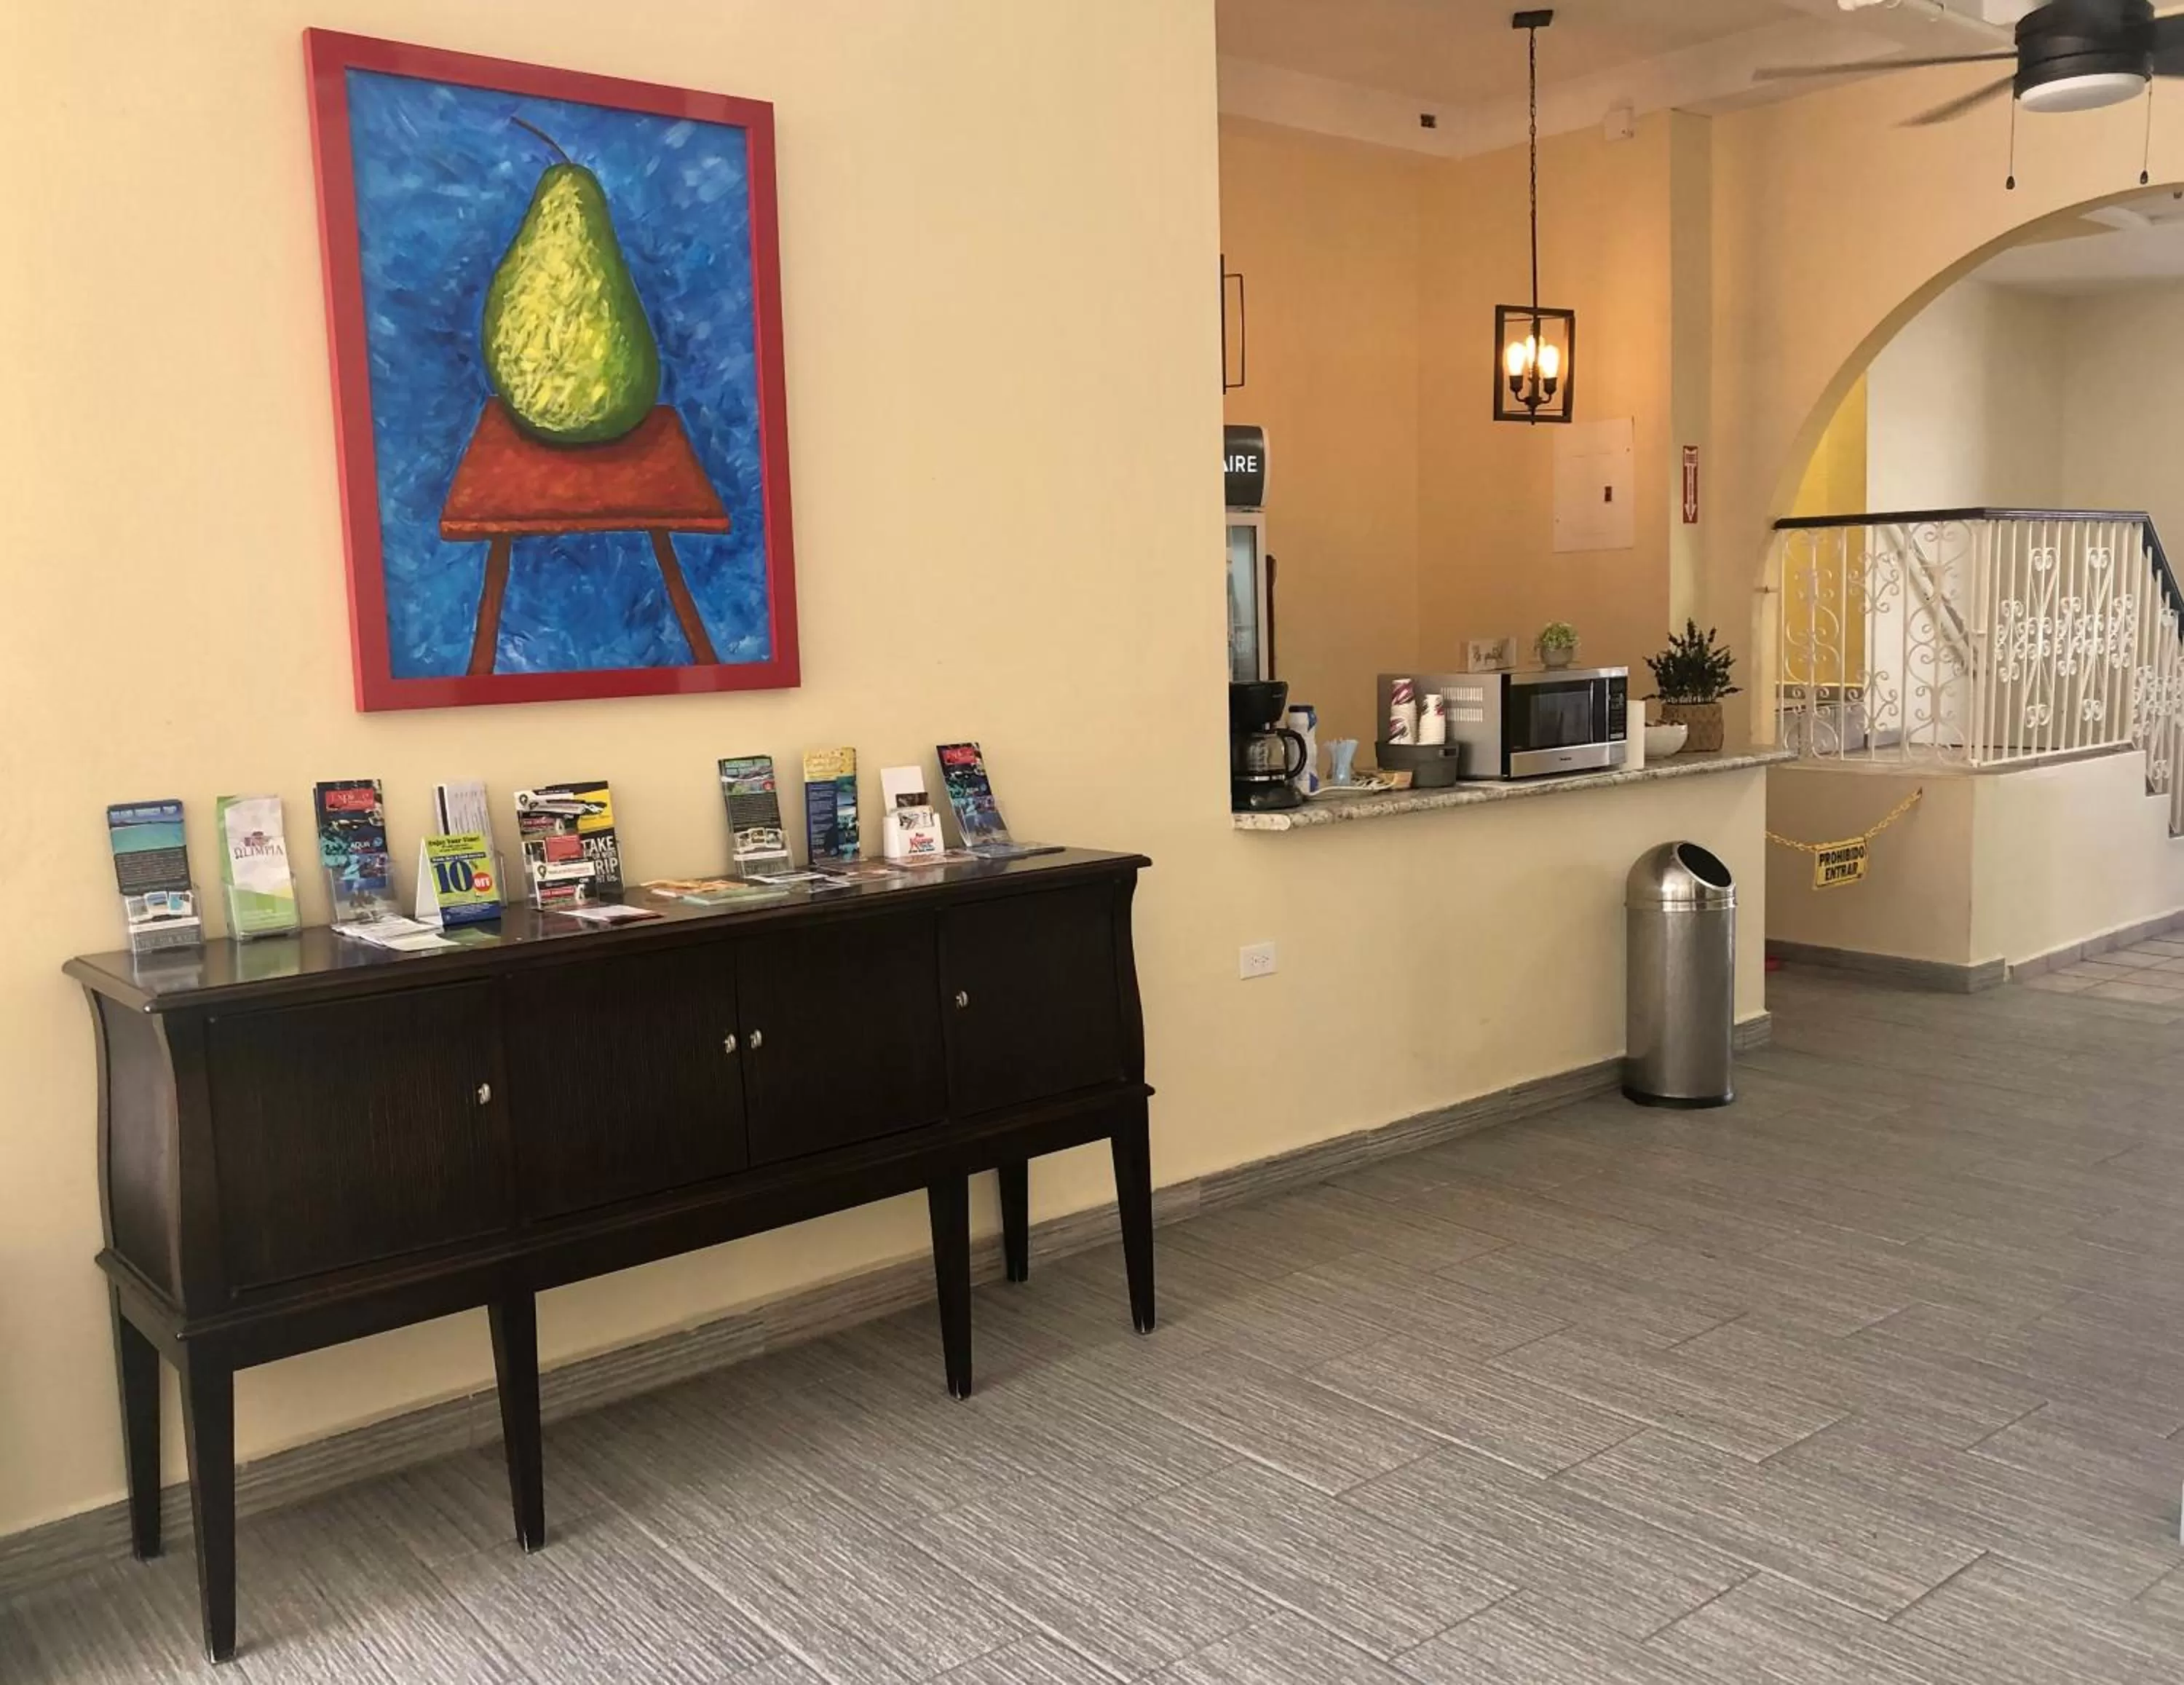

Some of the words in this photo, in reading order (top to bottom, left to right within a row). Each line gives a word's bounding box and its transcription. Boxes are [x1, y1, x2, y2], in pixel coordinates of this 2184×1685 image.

[580, 835, 614, 854] TAKE
[1819, 845, 1864, 867] PROHIBIDO
[596, 858, 618, 875] RIP
[1825, 862, 1858, 880] ENTRAR
[474, 877, 491, 888] OFF
